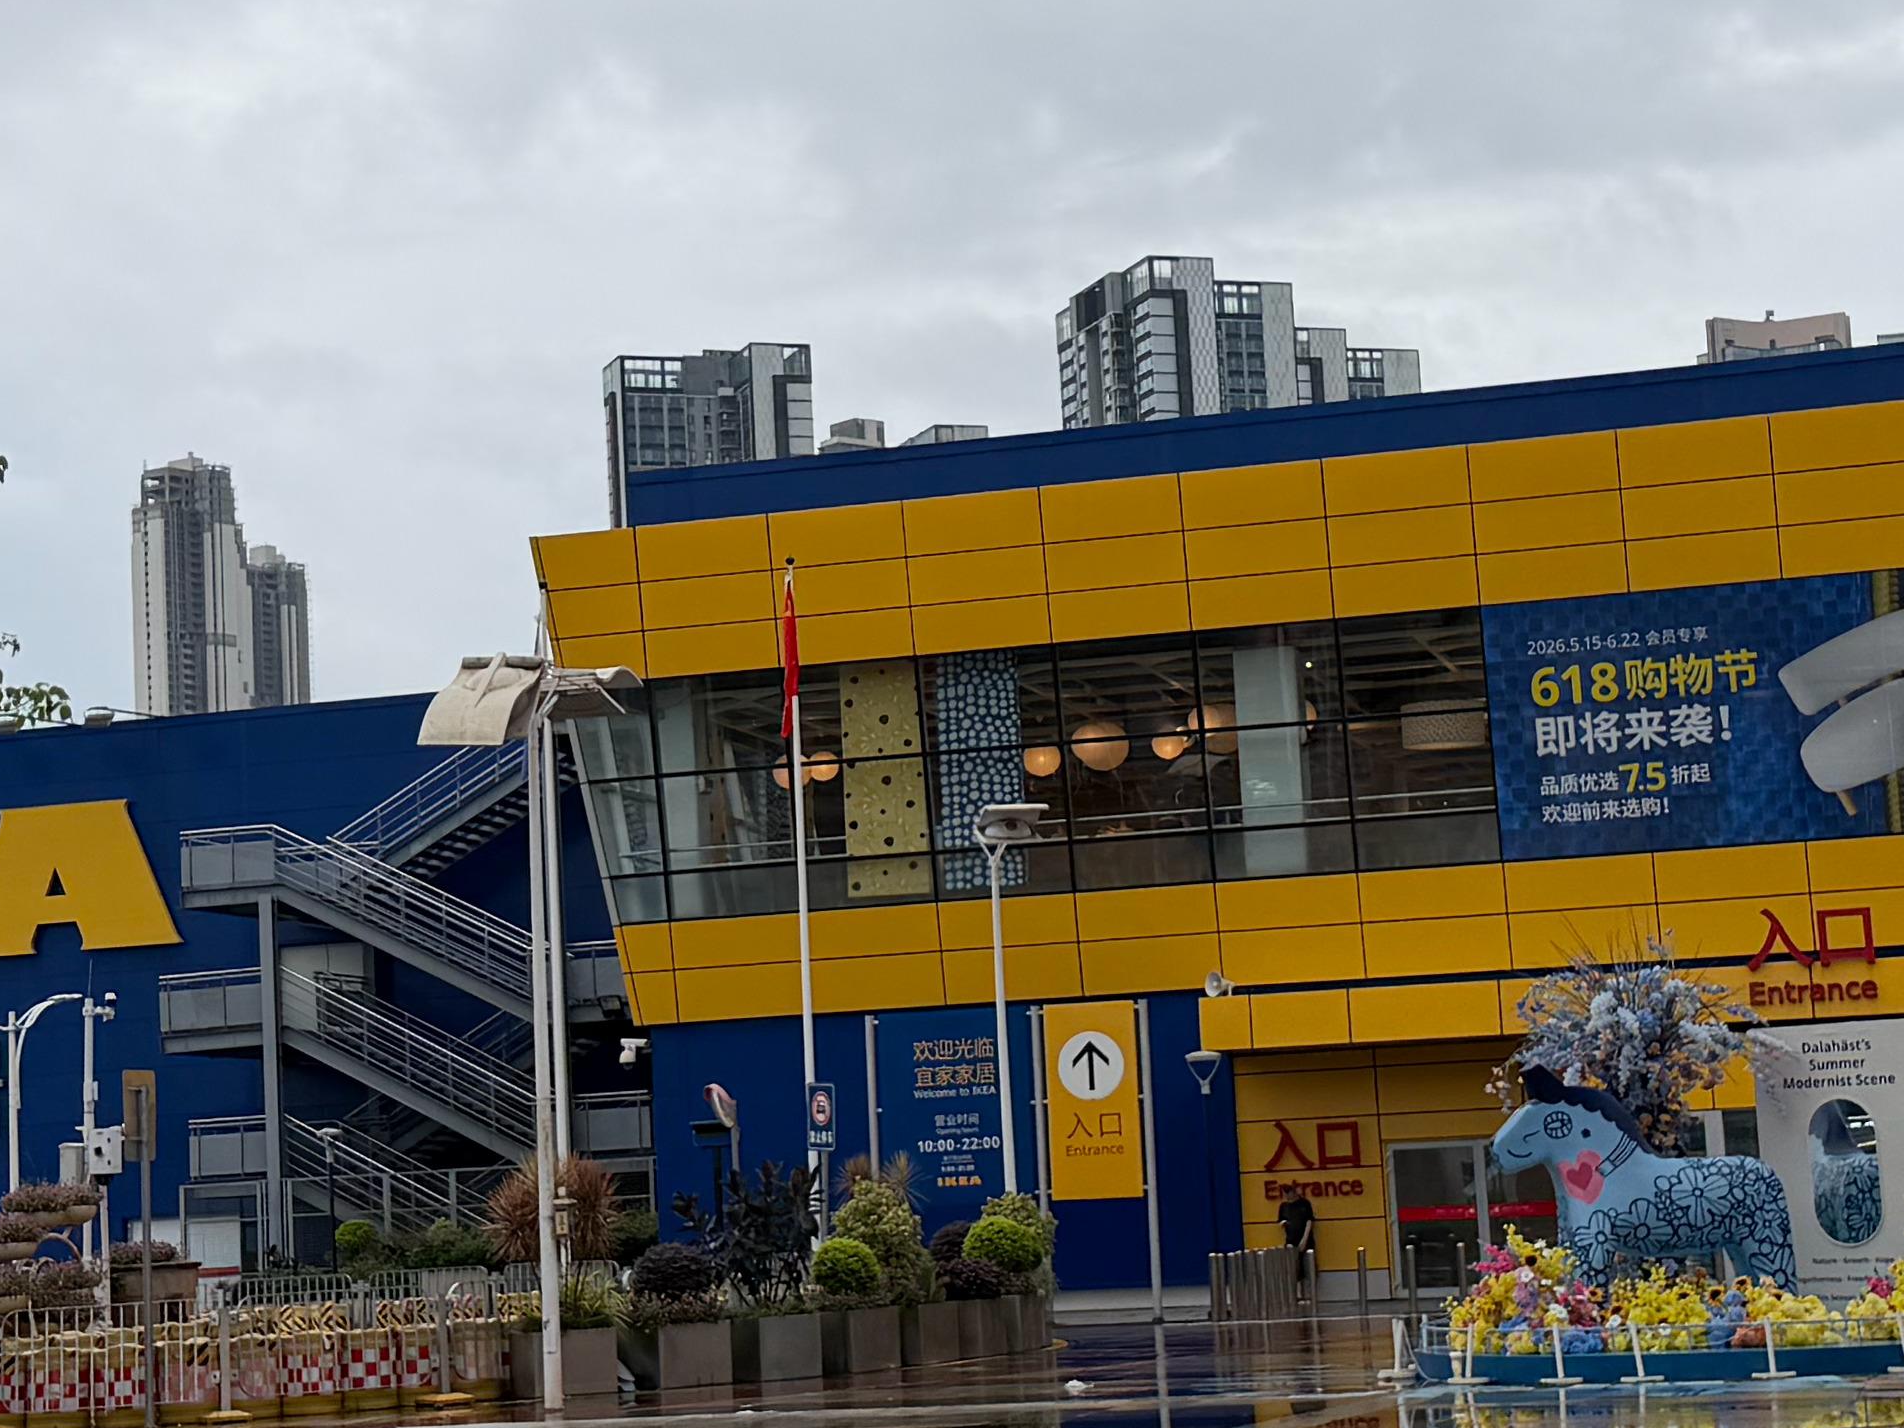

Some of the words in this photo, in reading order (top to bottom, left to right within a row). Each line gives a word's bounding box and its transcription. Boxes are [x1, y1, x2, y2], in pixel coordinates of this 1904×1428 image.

[1527, 632, 1640, 655] 2026.5.15-6.22
[1644, 626, 1709, 646] 会员专享
[1530, 648, 1758, 707] 618购物节
[1535, 703, 1733, 758] 即将来袭!
[1748, 906, 1876, 972] 入口
[1749, 979, 1879, 1007] Entrance
[913, 1036, 995, 1062] 欢迎光临
[914, 1061, 995, 1088] 宜家家居
[1809, 1058, 1866, 1072] Summer
[913, 1089, 957, 1099] Welcome
[959, 1087, 969, 1096] to
[972, 1085, 996, 1096] IKEA
[1782, 1075, 1853, 1090] Modernist
[1855, 1073, 1896, 1086] Scene
[1067, 1112, 1123, 1139] 入口
[1065, 1144, 1125, 1157] Entrance
[1264, 1121, 1361, 1171] 入口
